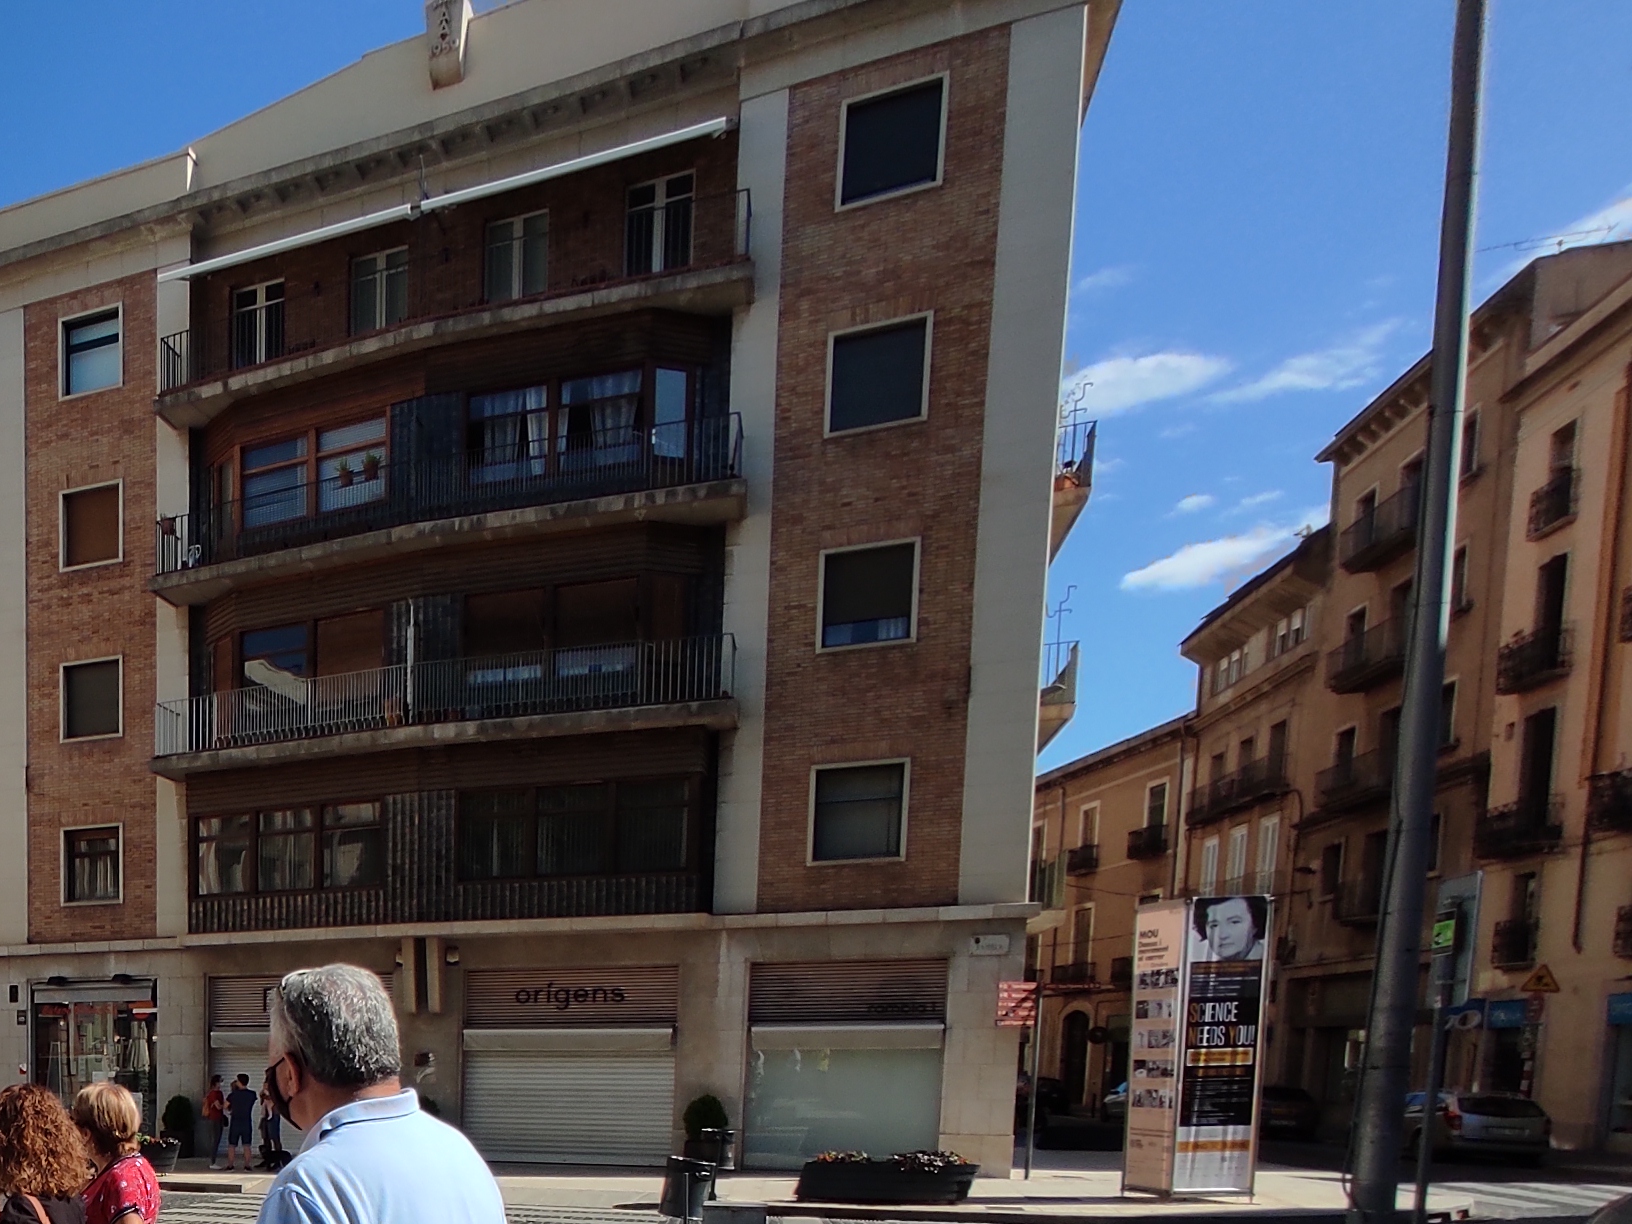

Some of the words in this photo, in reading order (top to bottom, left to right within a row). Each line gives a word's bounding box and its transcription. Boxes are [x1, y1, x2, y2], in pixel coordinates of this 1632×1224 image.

[1188, 1002, 1239, 1023] SCIENCE
[1188, 1025, 1226, 1046] NEEDS
[1228, 1025, 1256, 1045] YOU!
